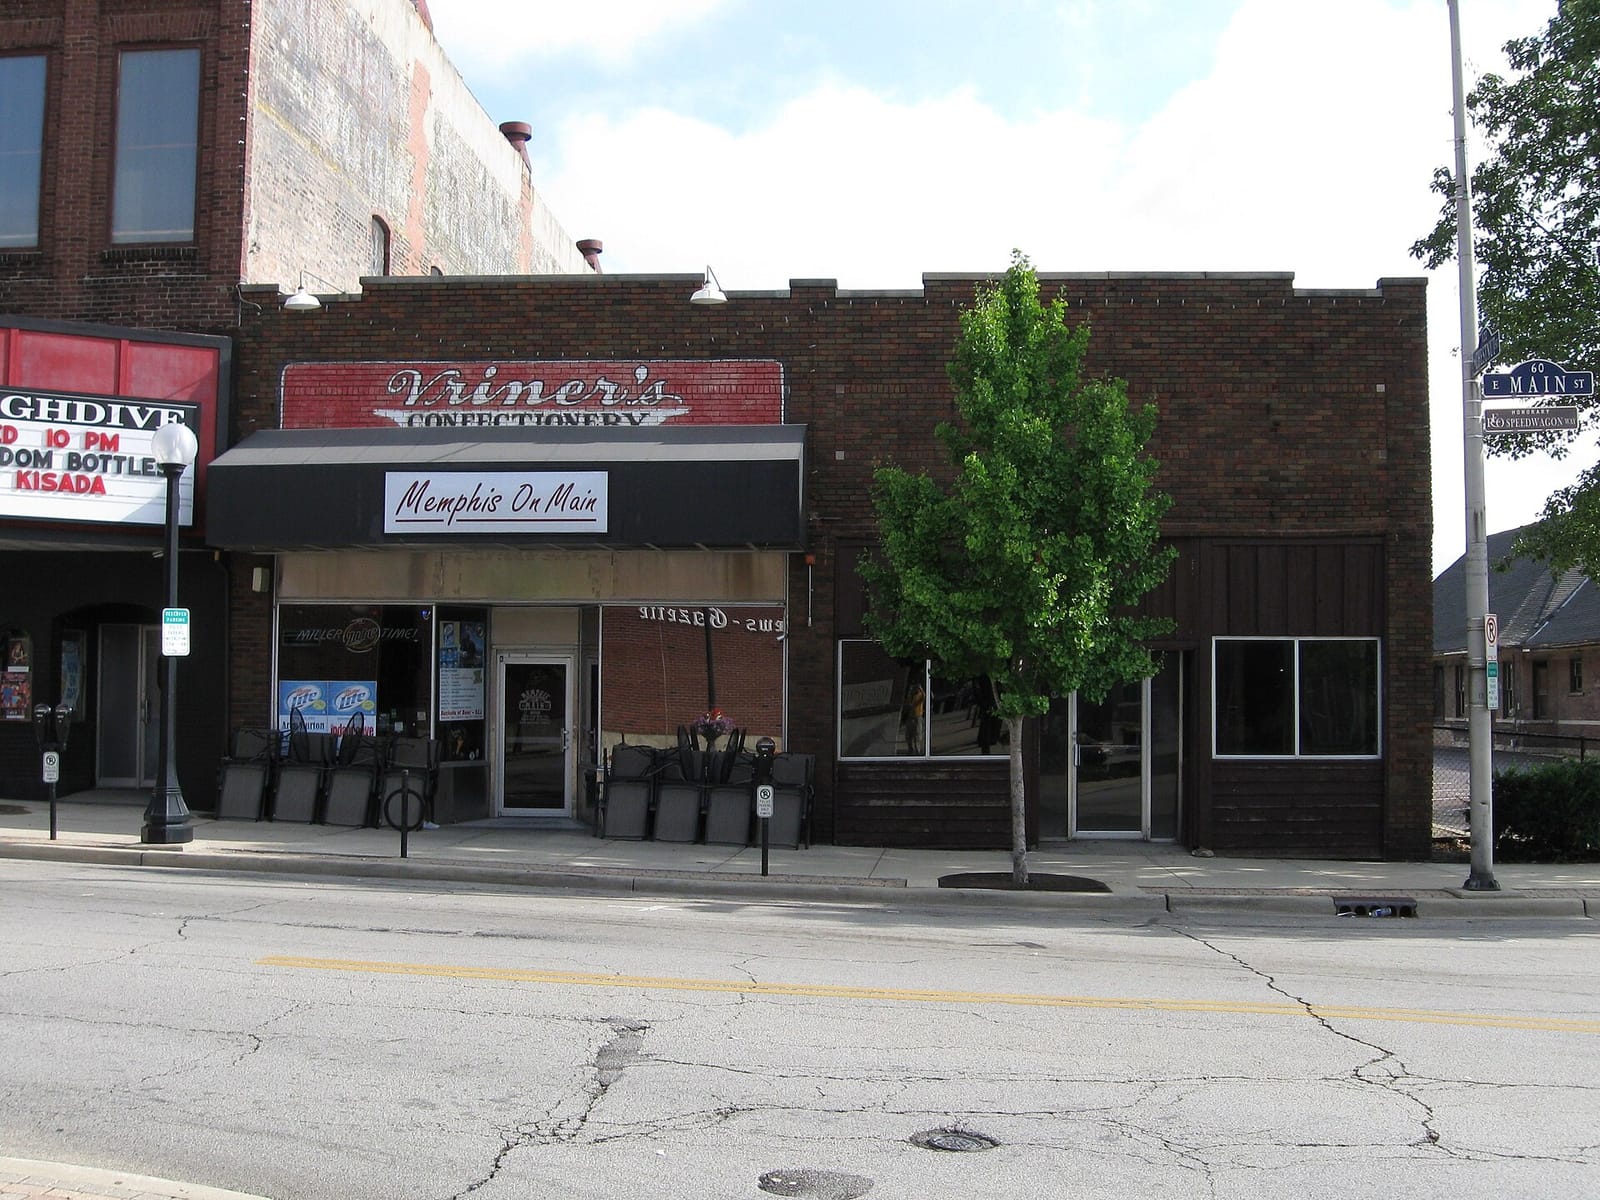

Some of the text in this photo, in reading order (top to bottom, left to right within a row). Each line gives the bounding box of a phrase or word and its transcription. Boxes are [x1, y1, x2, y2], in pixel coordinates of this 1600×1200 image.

[1531, 363, 1544, 373] 60
[387, 365, 683, 406] Vriner's
[1493, 376, 1585, 393] E MAIN ST
[1506, 417, 1565, 428] SPEEDWAGON
[46, 428, 70, 448] 10
[85, 432, 119, 452] PM
[16, 470, 106, 495] KISADA
[395, 480, 597, 526] Memphis On Main
[295, 628, 343, 641] MILLER
[381, 628, 418, 642] TIME!
